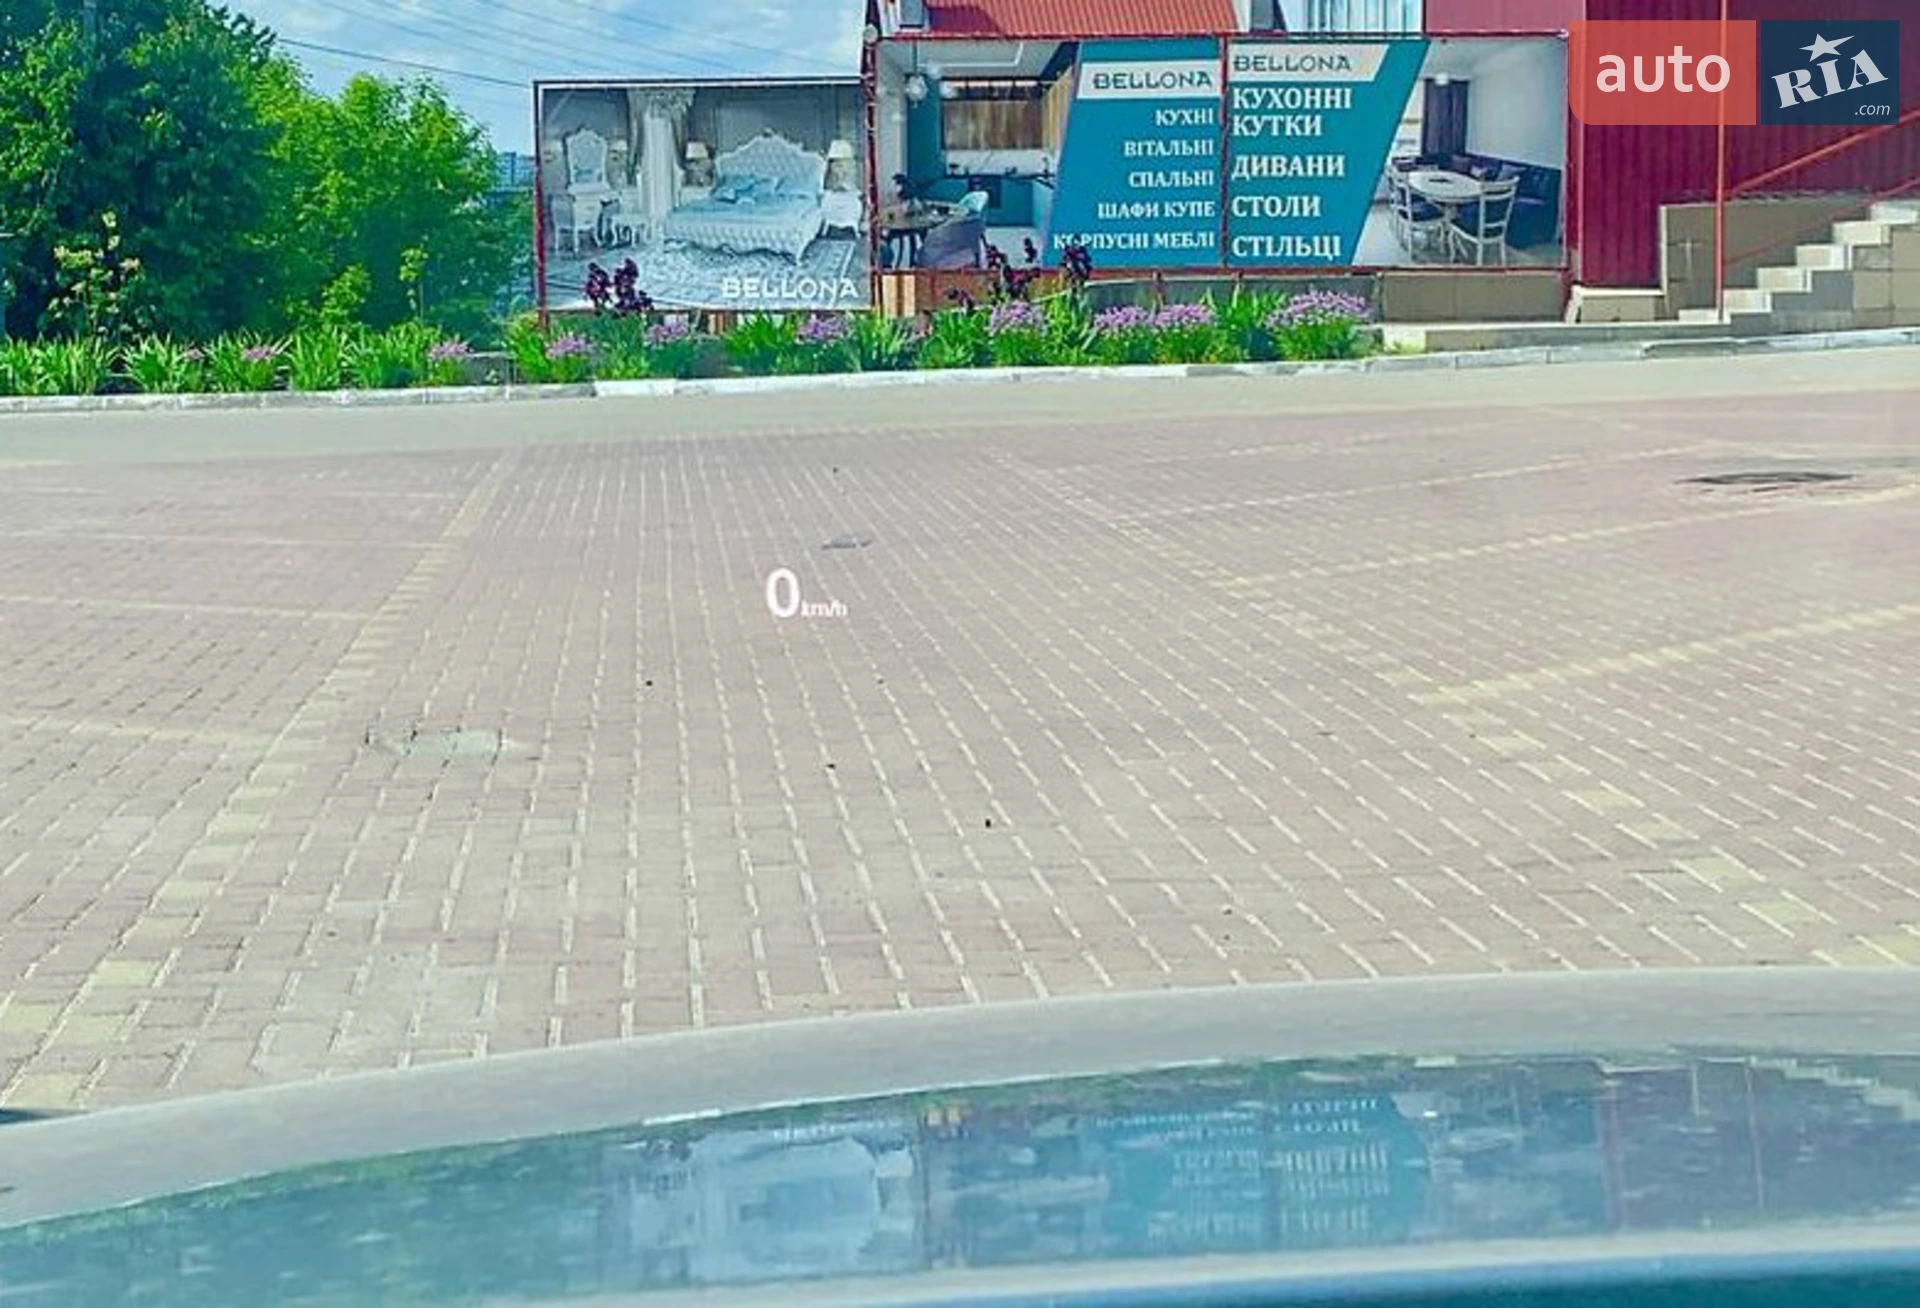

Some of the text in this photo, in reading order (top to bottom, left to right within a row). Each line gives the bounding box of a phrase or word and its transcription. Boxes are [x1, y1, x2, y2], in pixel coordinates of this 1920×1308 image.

[1233, 55, 1353, 72] BELLONA
[1093, 70, 1213, 90] BELLONA
[1232, 87, 1353, 110] КУХОННІ
[1155, 107, 1214, 126] КУХНІ
[1232, 114, 1322, 137] КУТКИ
[1123, 139, 1214, 158] ВІТАЛЬНІ
[1231, 154, 1346, 182] ДИВАНИ
[1128, 170, 1214, 188] СПАЛЬНІ
[1098, 200, 1215, 219] ШАФИ КУПЕ
[1231, 195, 1322, 218] СТОЛИ
[1153, 231, 1215, 248] МЕБЛІ
[1231, 235, 1341, 261] СТІЛЬЦІ
[721, 277, 859, 299] BELLONA
[766, 567, 848, 618] 0 km/h
